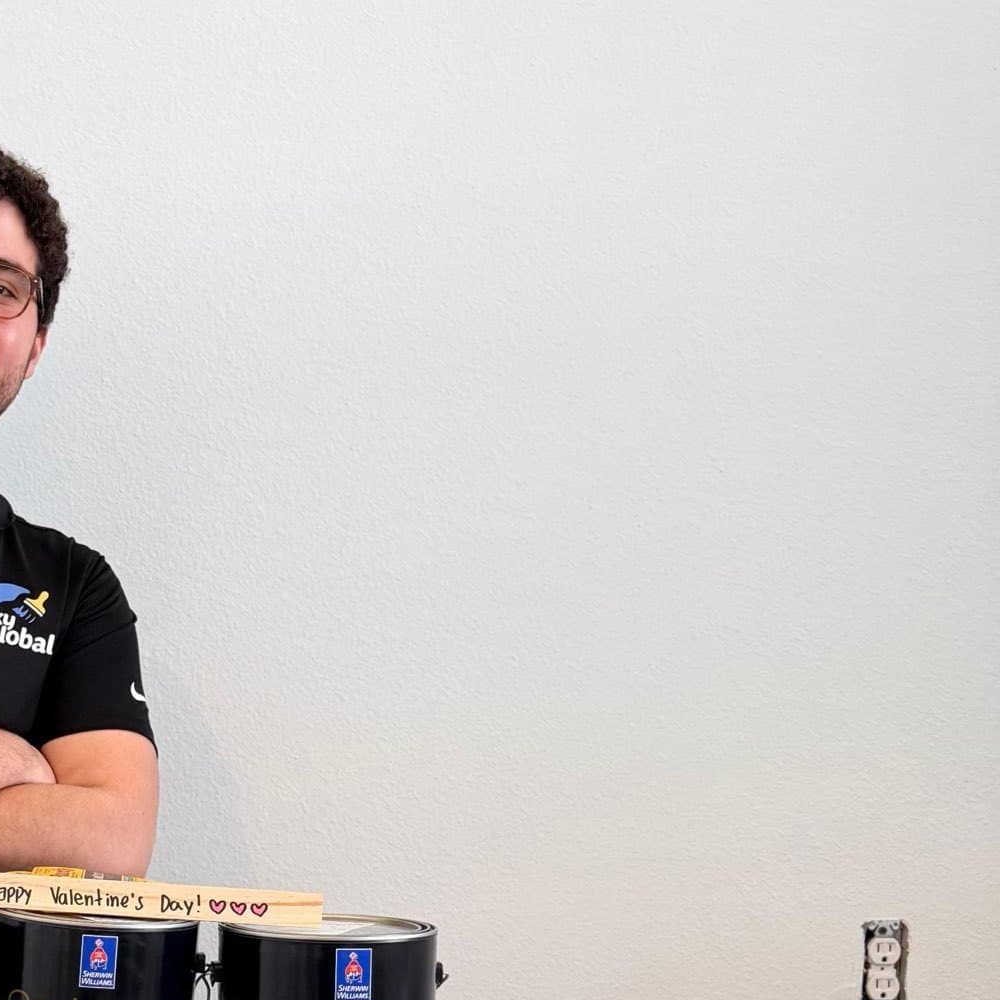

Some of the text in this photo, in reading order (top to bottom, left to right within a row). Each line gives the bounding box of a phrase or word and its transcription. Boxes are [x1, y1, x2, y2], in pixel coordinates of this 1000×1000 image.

[50, 886, 144, 910] Valentine's
[160, 894, 202, 916] Day!
[83, 971, 112, 979] SHERWIN
[81, 977, 113, 986] WILLIAMS
